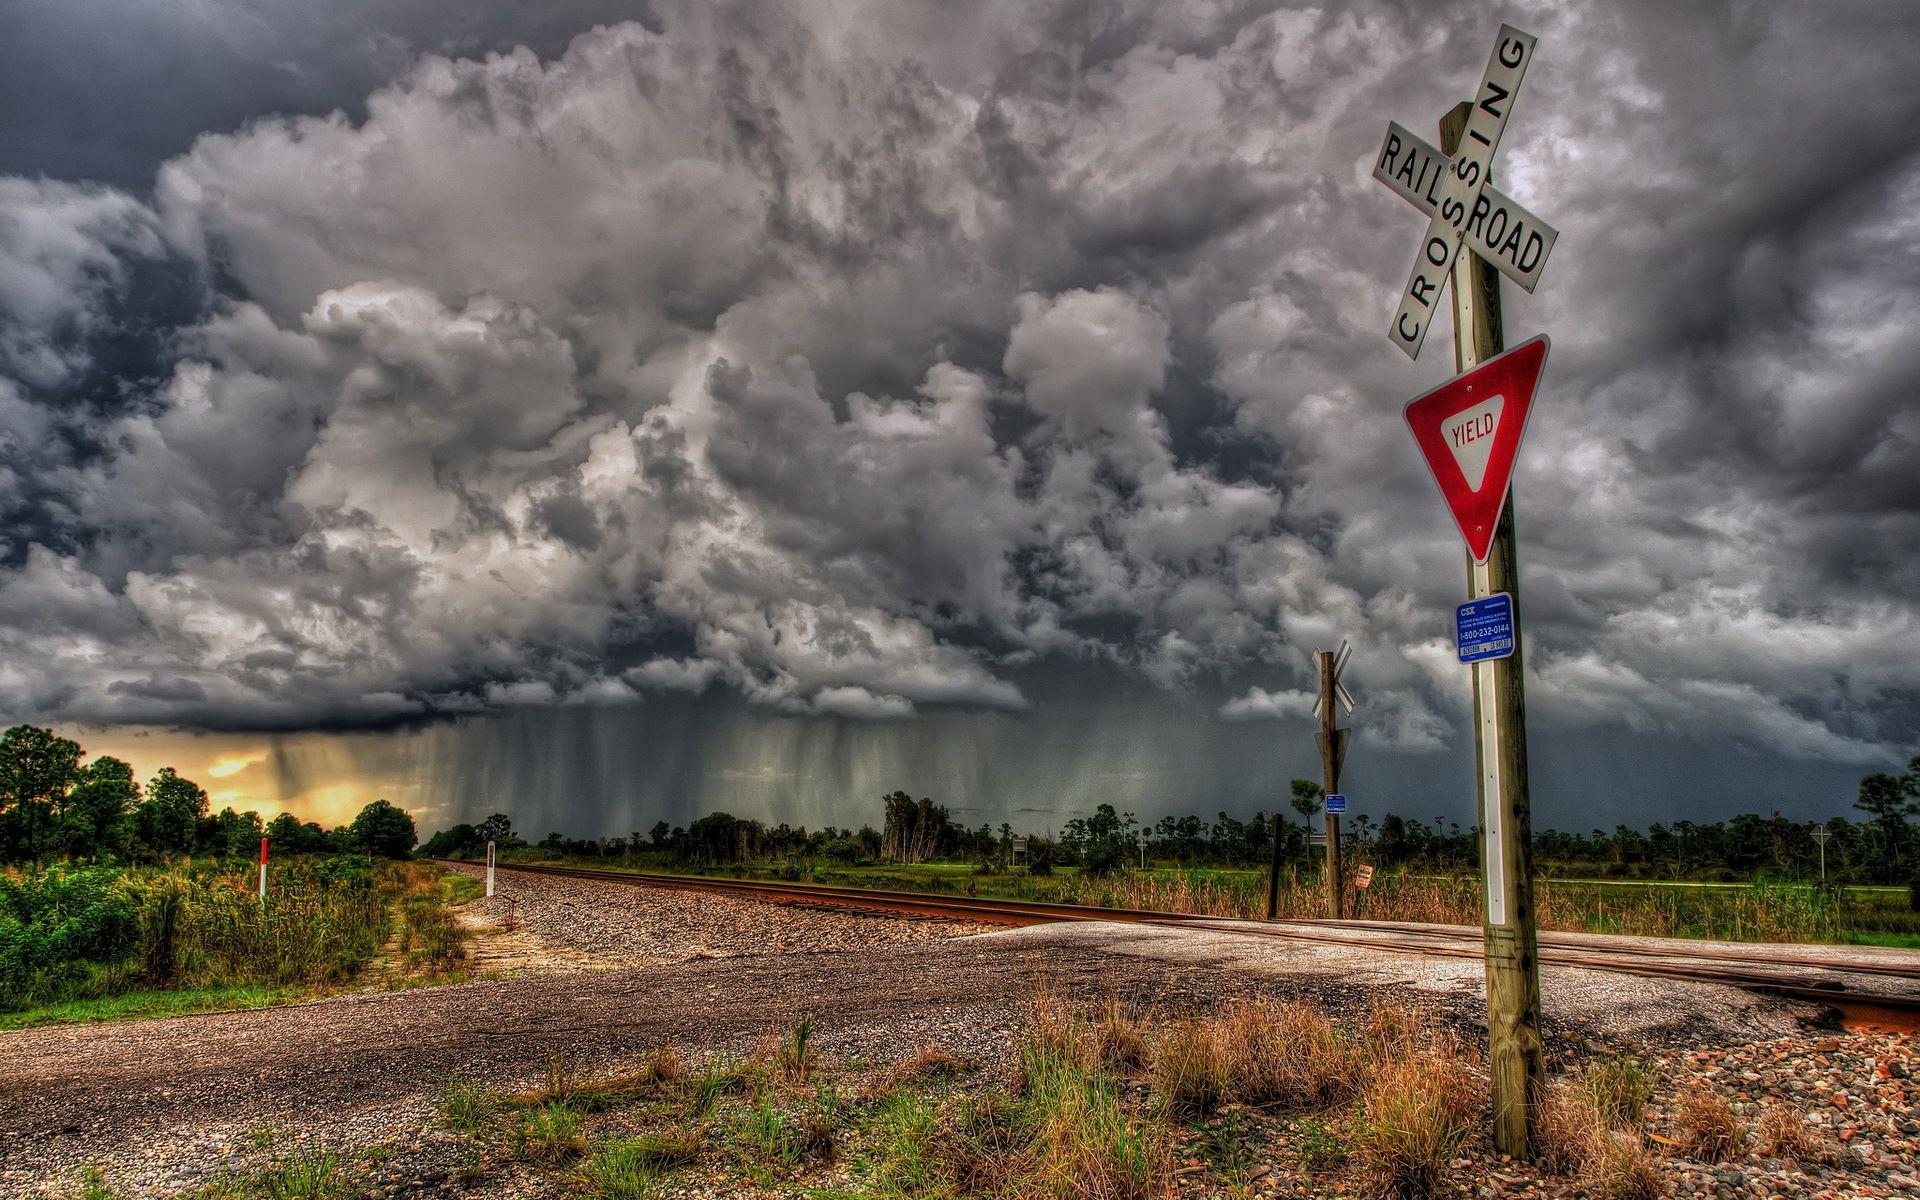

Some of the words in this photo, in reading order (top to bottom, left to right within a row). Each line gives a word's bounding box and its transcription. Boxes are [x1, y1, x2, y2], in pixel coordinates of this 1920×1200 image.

[1380, 133, 1442, 206] RAIL
[1466, 194, 1543, 274] ROAD
[1399, 37, 1524, 342] CROSSING
[1452, 412, 1493, 448] YIELD
[1461, 606, 1475, 616] CSX
[1460, 624, 1509, 640] 1-800-232-0144
